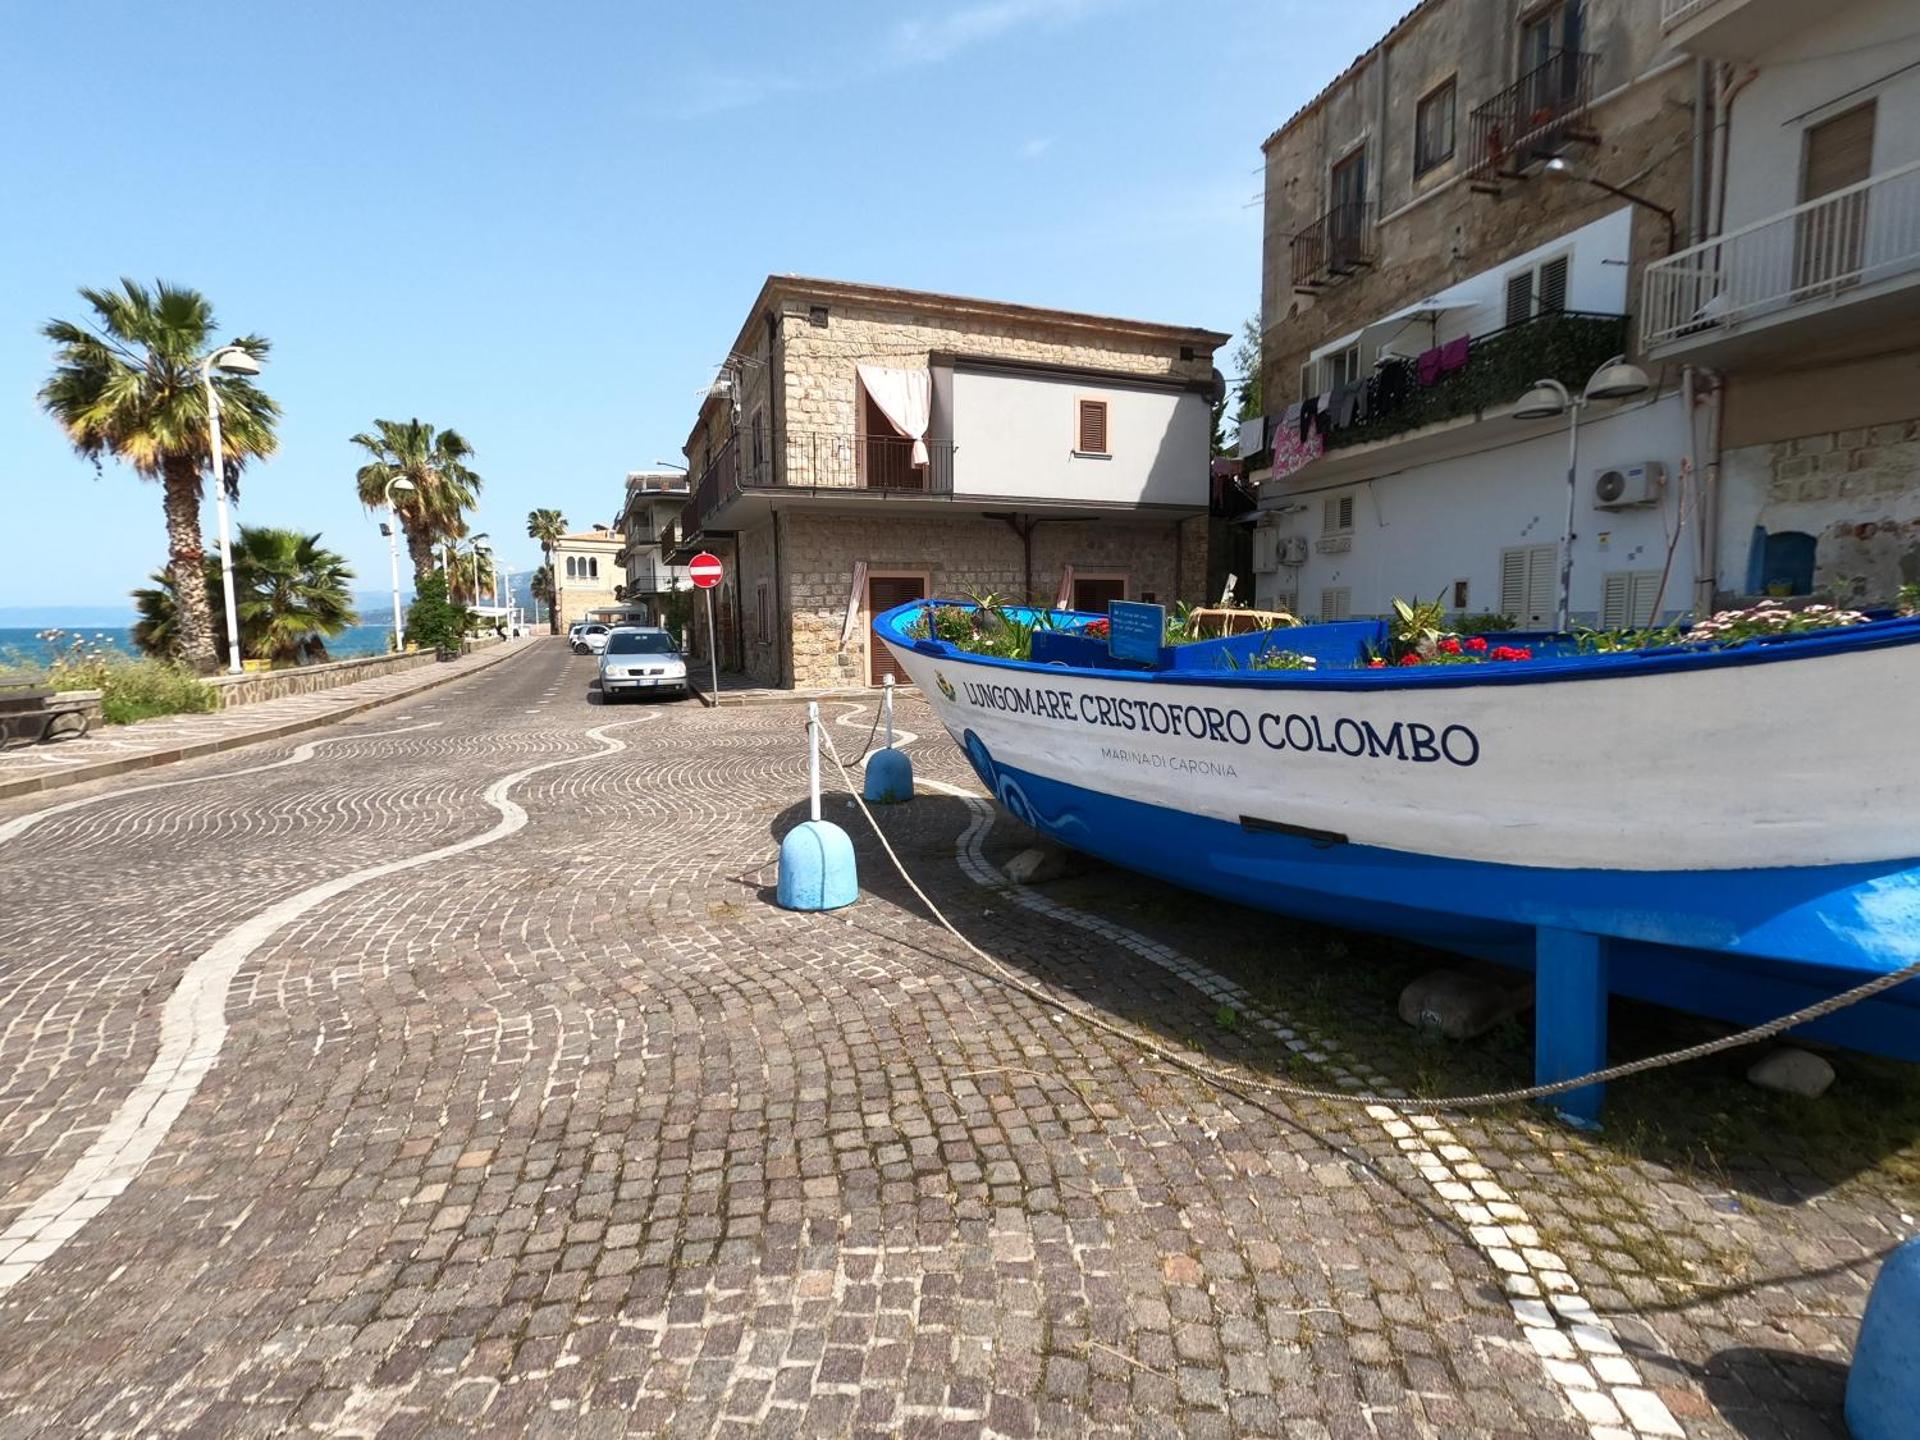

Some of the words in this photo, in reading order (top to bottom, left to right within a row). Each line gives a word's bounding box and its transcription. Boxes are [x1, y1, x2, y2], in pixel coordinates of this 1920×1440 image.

[963, 681, 1079, 722] LUNGOMARE
[1080, 694, 1251, 745] CRISTOFORO
[1258, 712, 1480, 767] COLOMBO
[1101, 748, 1151, 766] MARINA
[1151, 754, 1166, 768] DI
[1169, 757, 1237, 777] CARONIA
